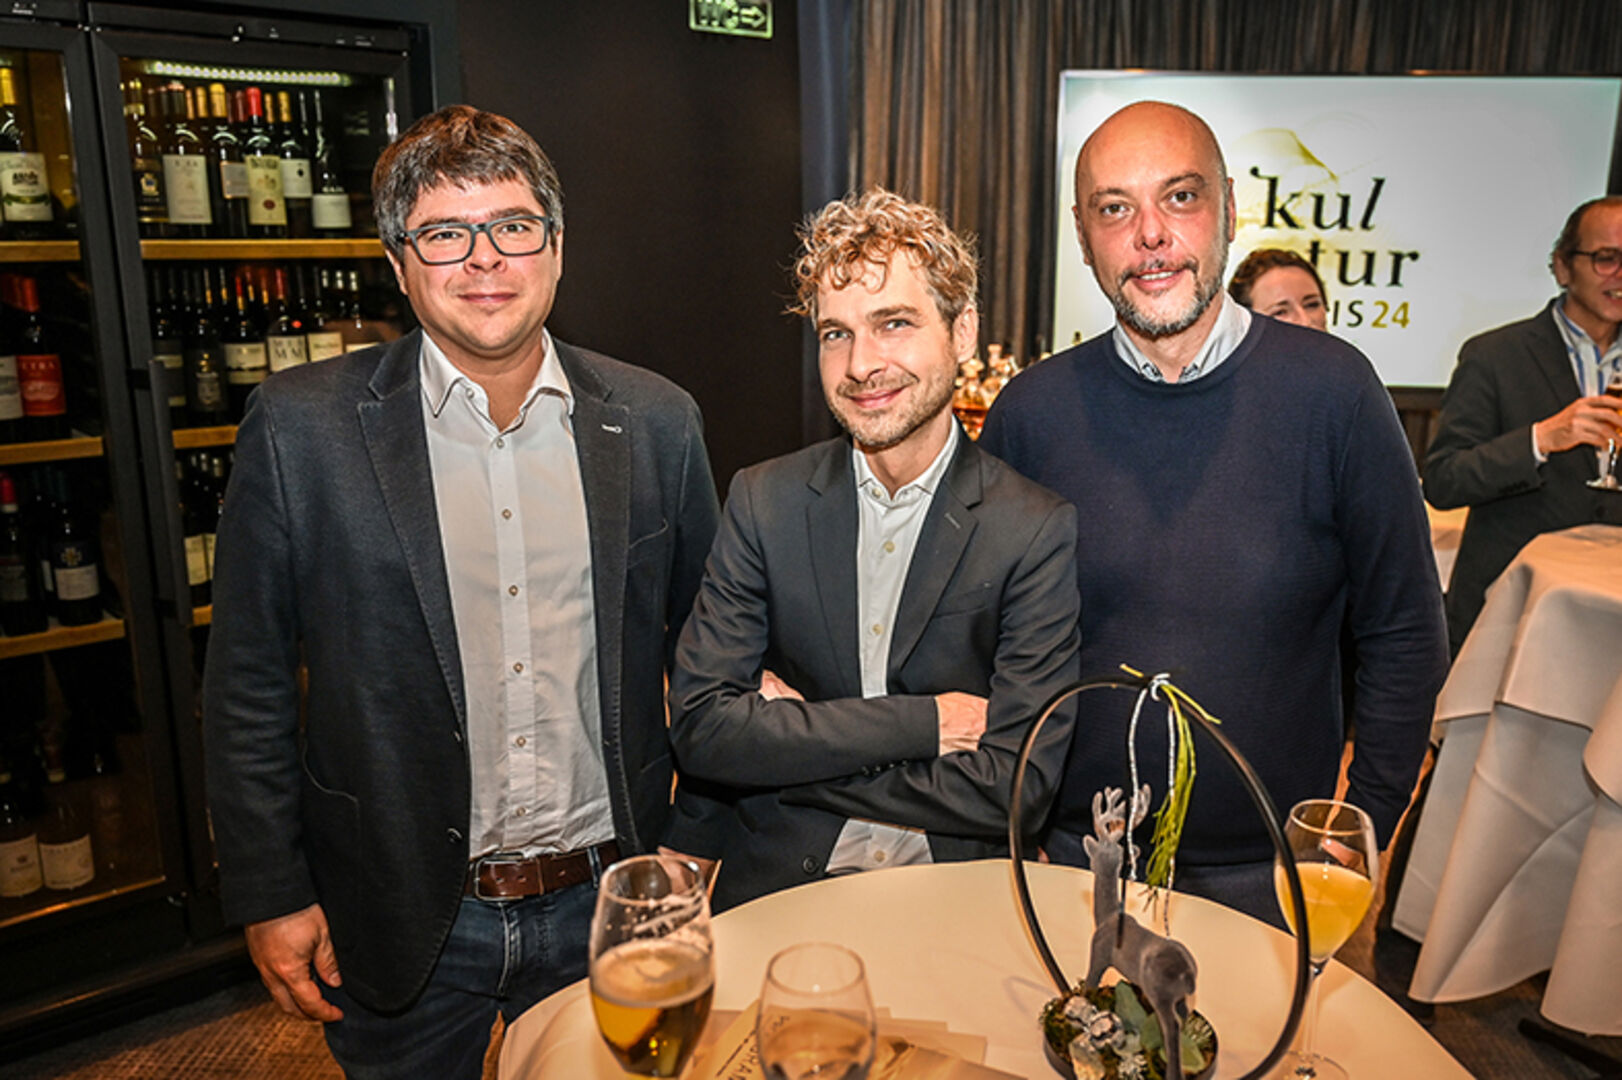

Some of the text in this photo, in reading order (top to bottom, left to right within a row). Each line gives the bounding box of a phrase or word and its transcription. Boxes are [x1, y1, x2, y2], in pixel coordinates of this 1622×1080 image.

[1250, 167, 1385, 230] kul
[1306, 240, 1420, 288] tur
[1331, 299, 1411, 329] IS24
